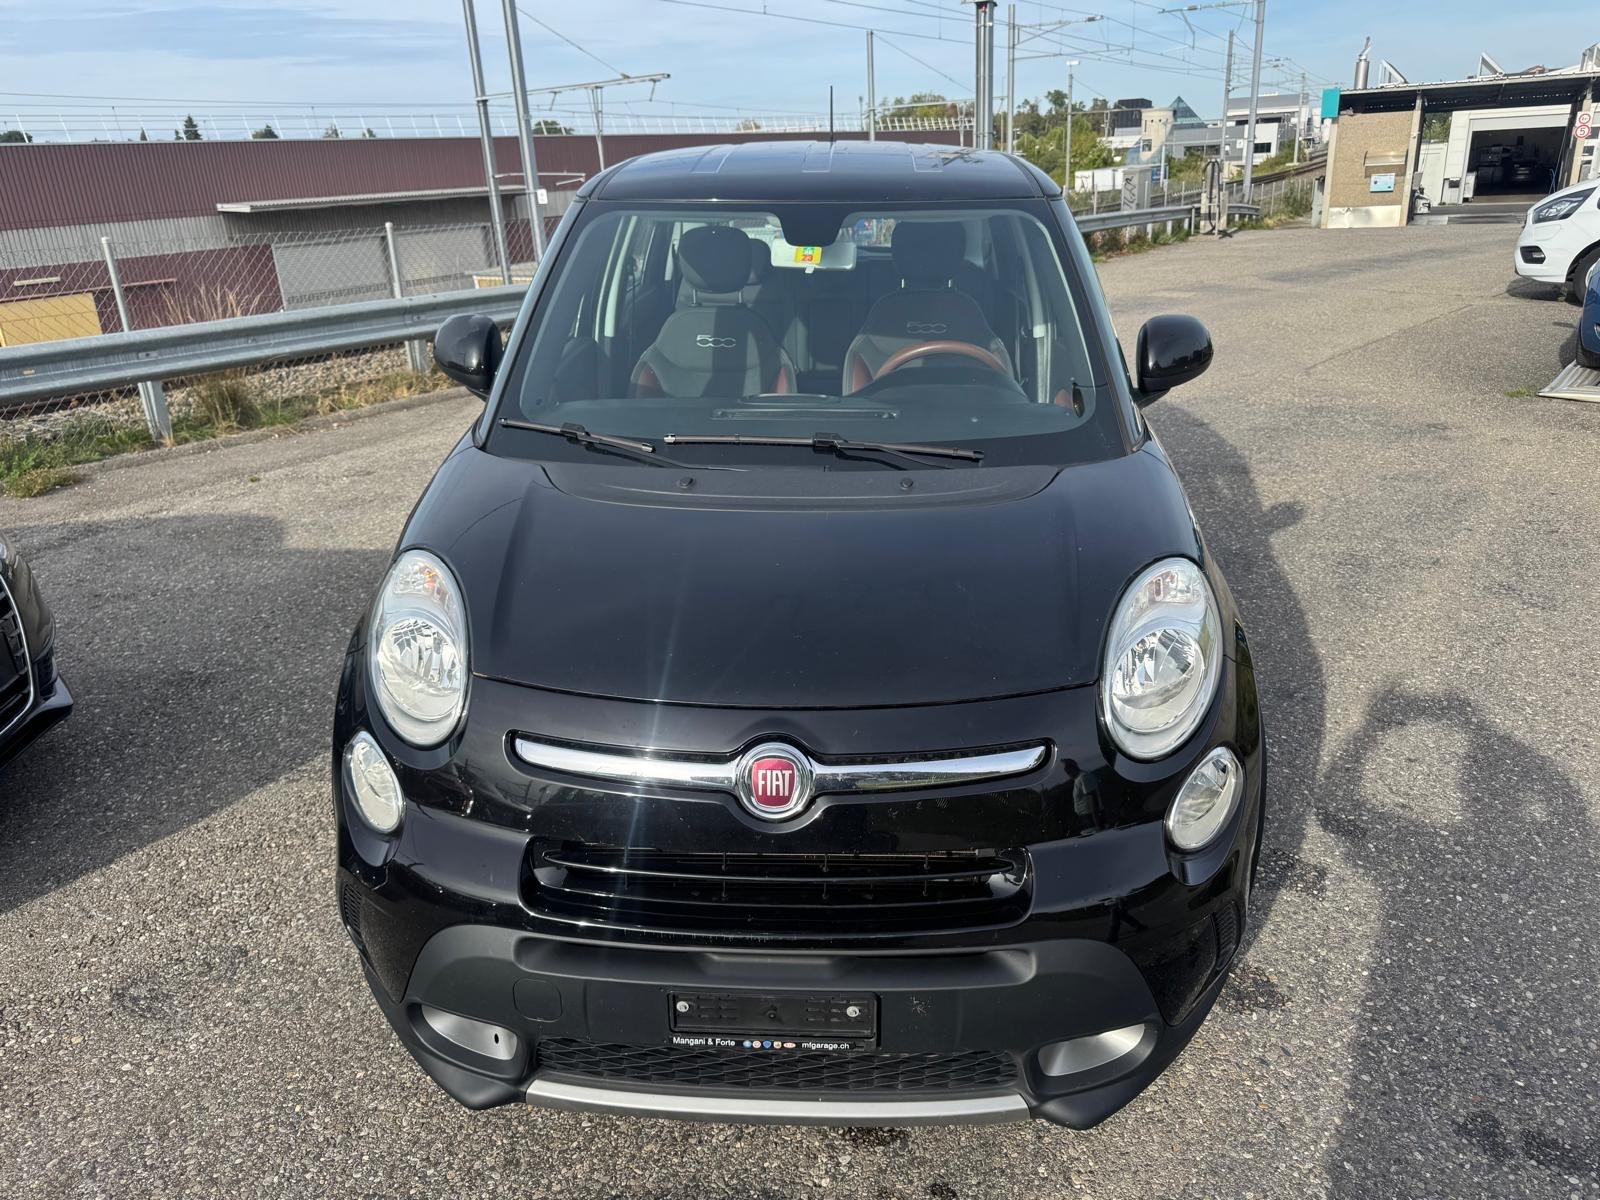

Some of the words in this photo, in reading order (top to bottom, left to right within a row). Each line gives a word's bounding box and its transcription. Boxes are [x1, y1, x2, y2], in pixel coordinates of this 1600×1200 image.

[1579, 127, 1586, 135] 5
[696, 334, 737, 348] 500
[757, 769, 793, 797] FIAT
[672, 1036, 706, 1046] Mangani
[707, 1038, 714, 1046] &
[715, 1038, 736, 1047] Forte
[801, 1042, 850, 1051] mfgarage.ch
